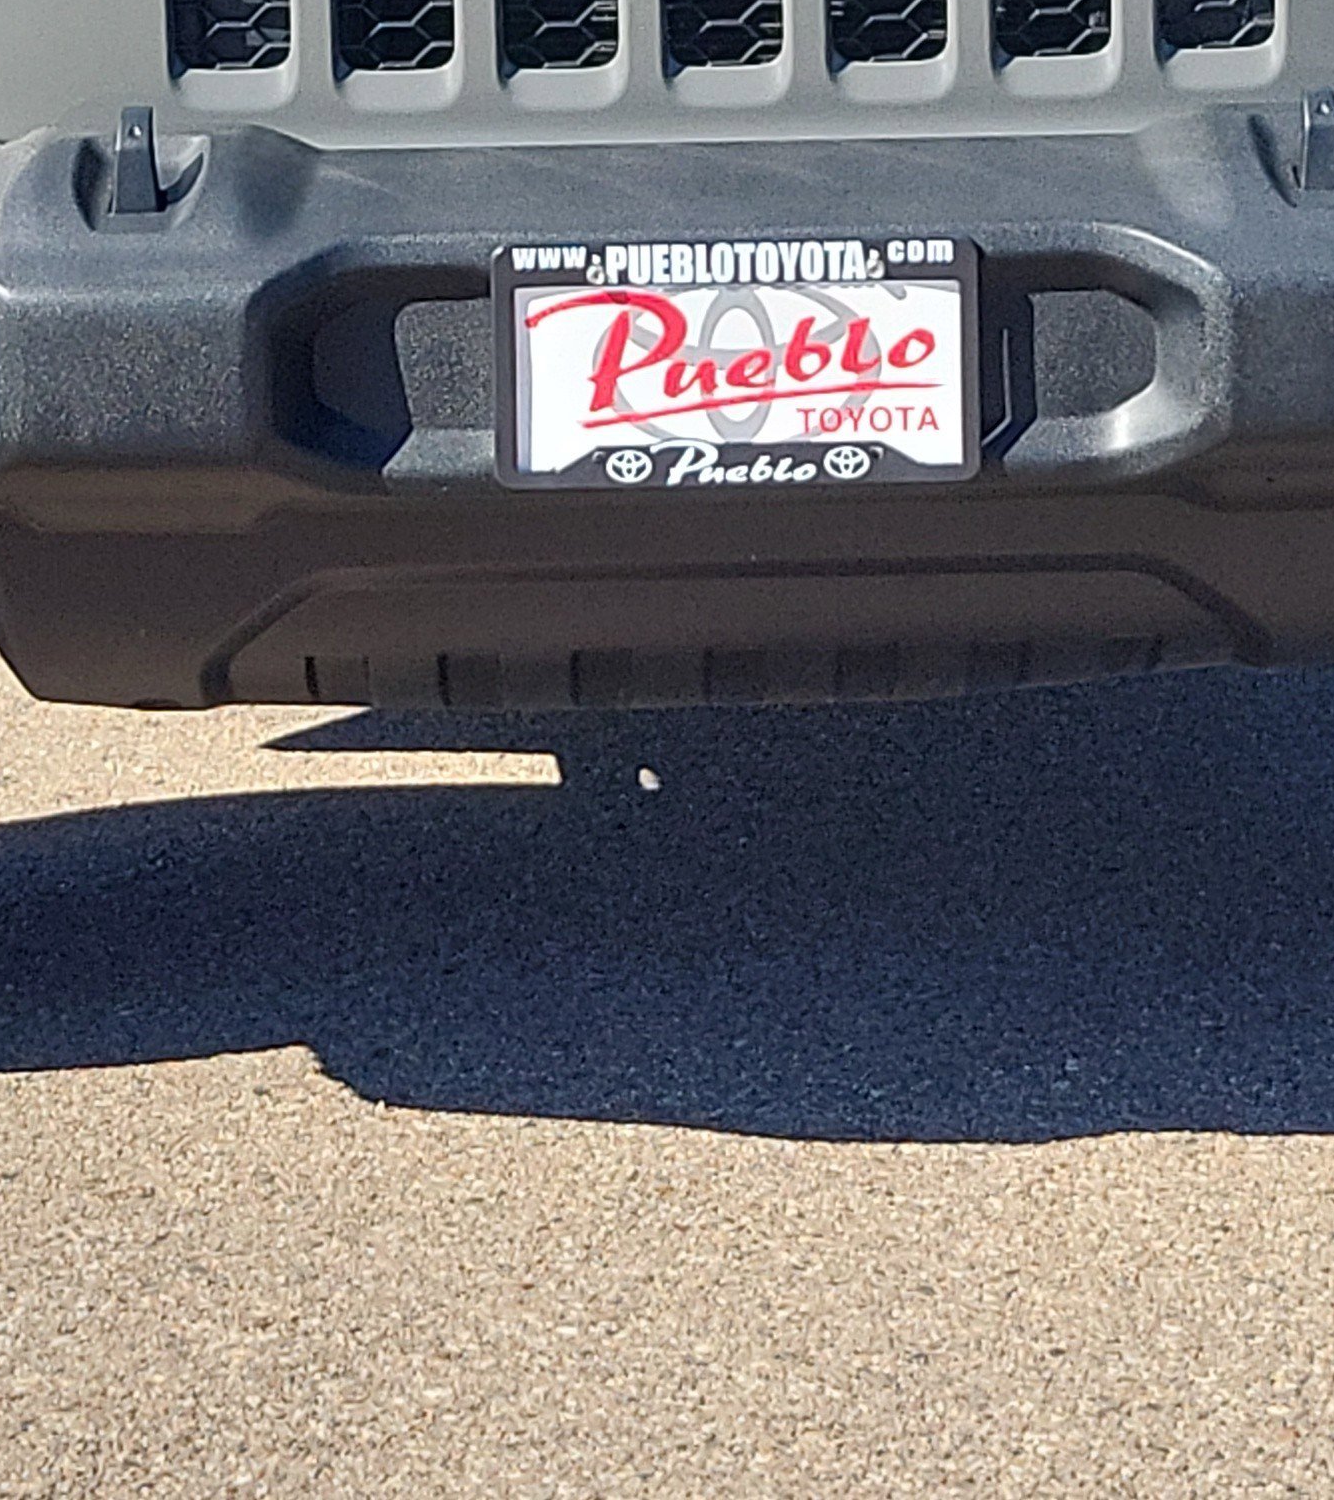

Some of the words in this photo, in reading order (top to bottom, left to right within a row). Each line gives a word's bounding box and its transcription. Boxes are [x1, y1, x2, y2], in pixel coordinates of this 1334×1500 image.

[524, 289, 938, 413] Pueblo
[796, 405, 940, 434] TOYOTA
[649, 439, 817, 485] Pueblo
